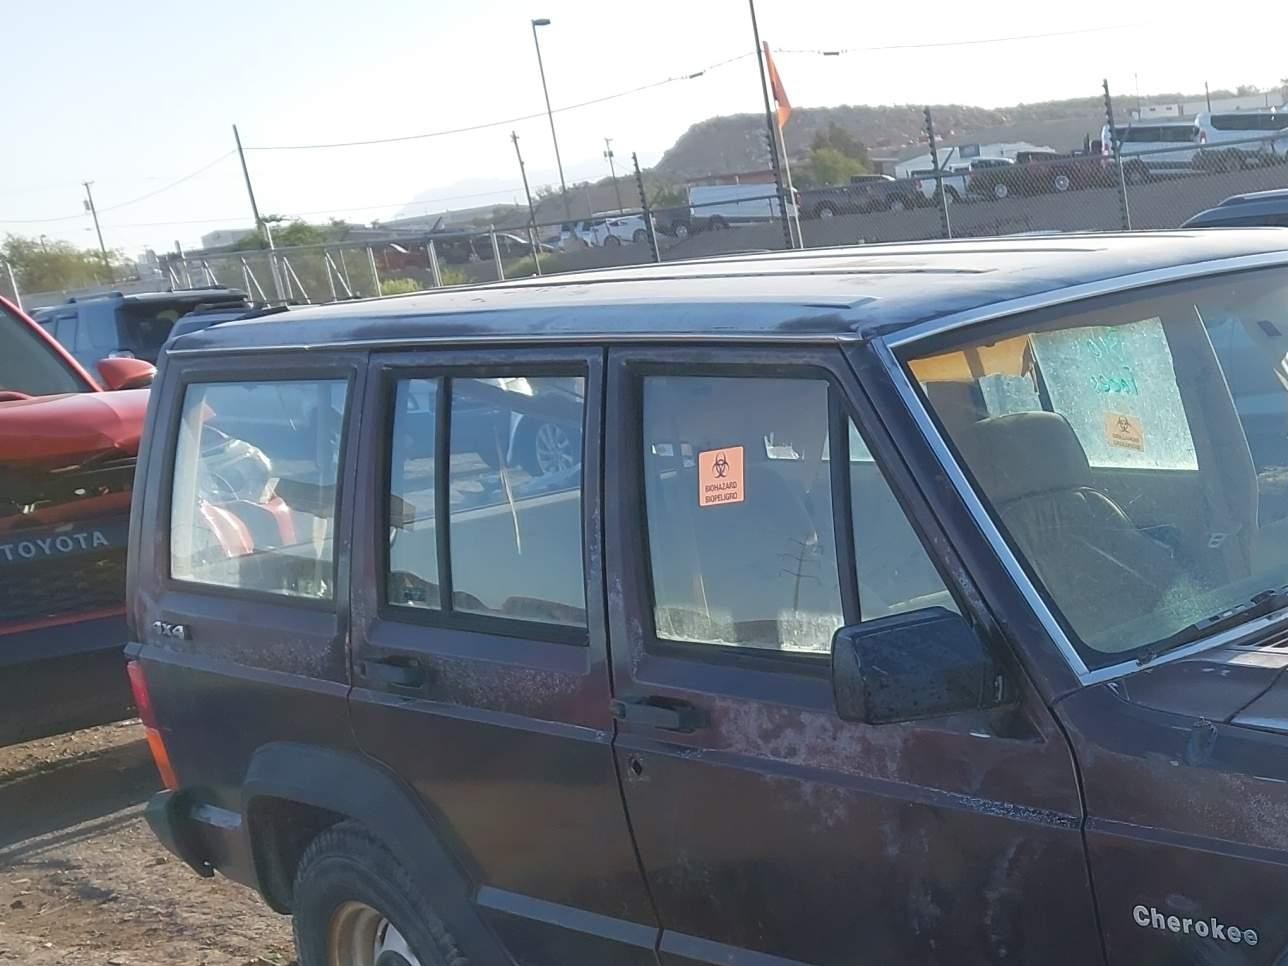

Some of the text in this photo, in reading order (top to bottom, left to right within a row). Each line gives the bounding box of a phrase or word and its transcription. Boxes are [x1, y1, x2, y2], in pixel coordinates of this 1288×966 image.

[705, 481, 738, 493] BIOHAZARD
[705, 492, 738, 503] BIOPELIGRO
[0, 530, 109, 561] TOYOTA
[1132, 904, 1259, 946] Cherokee
